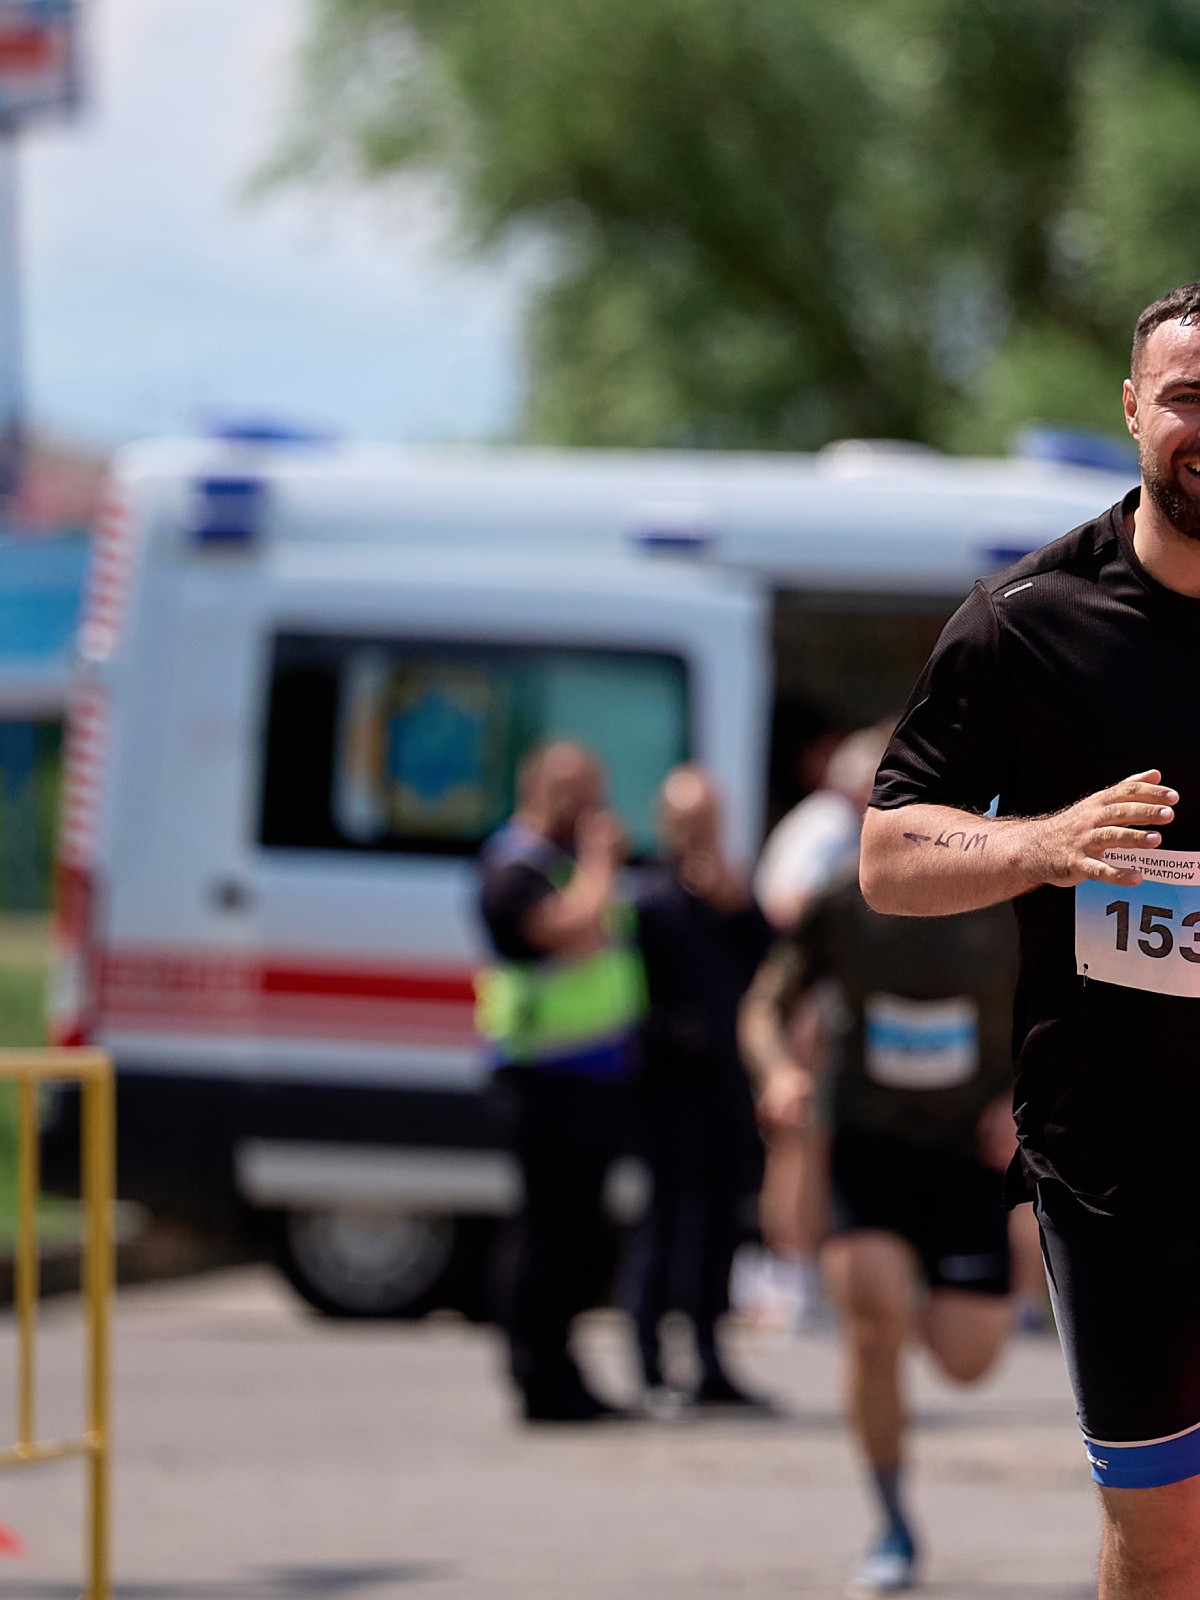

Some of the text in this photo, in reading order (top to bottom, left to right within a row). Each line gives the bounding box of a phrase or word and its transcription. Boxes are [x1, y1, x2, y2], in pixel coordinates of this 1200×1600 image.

[1102, 852, 1137, 863] УБНИЙ
[1138, 857, 1196, 869] ЧЕМПІОНАТ
[1138, 866, 1195, 880] ТРИАТЛОНУ
